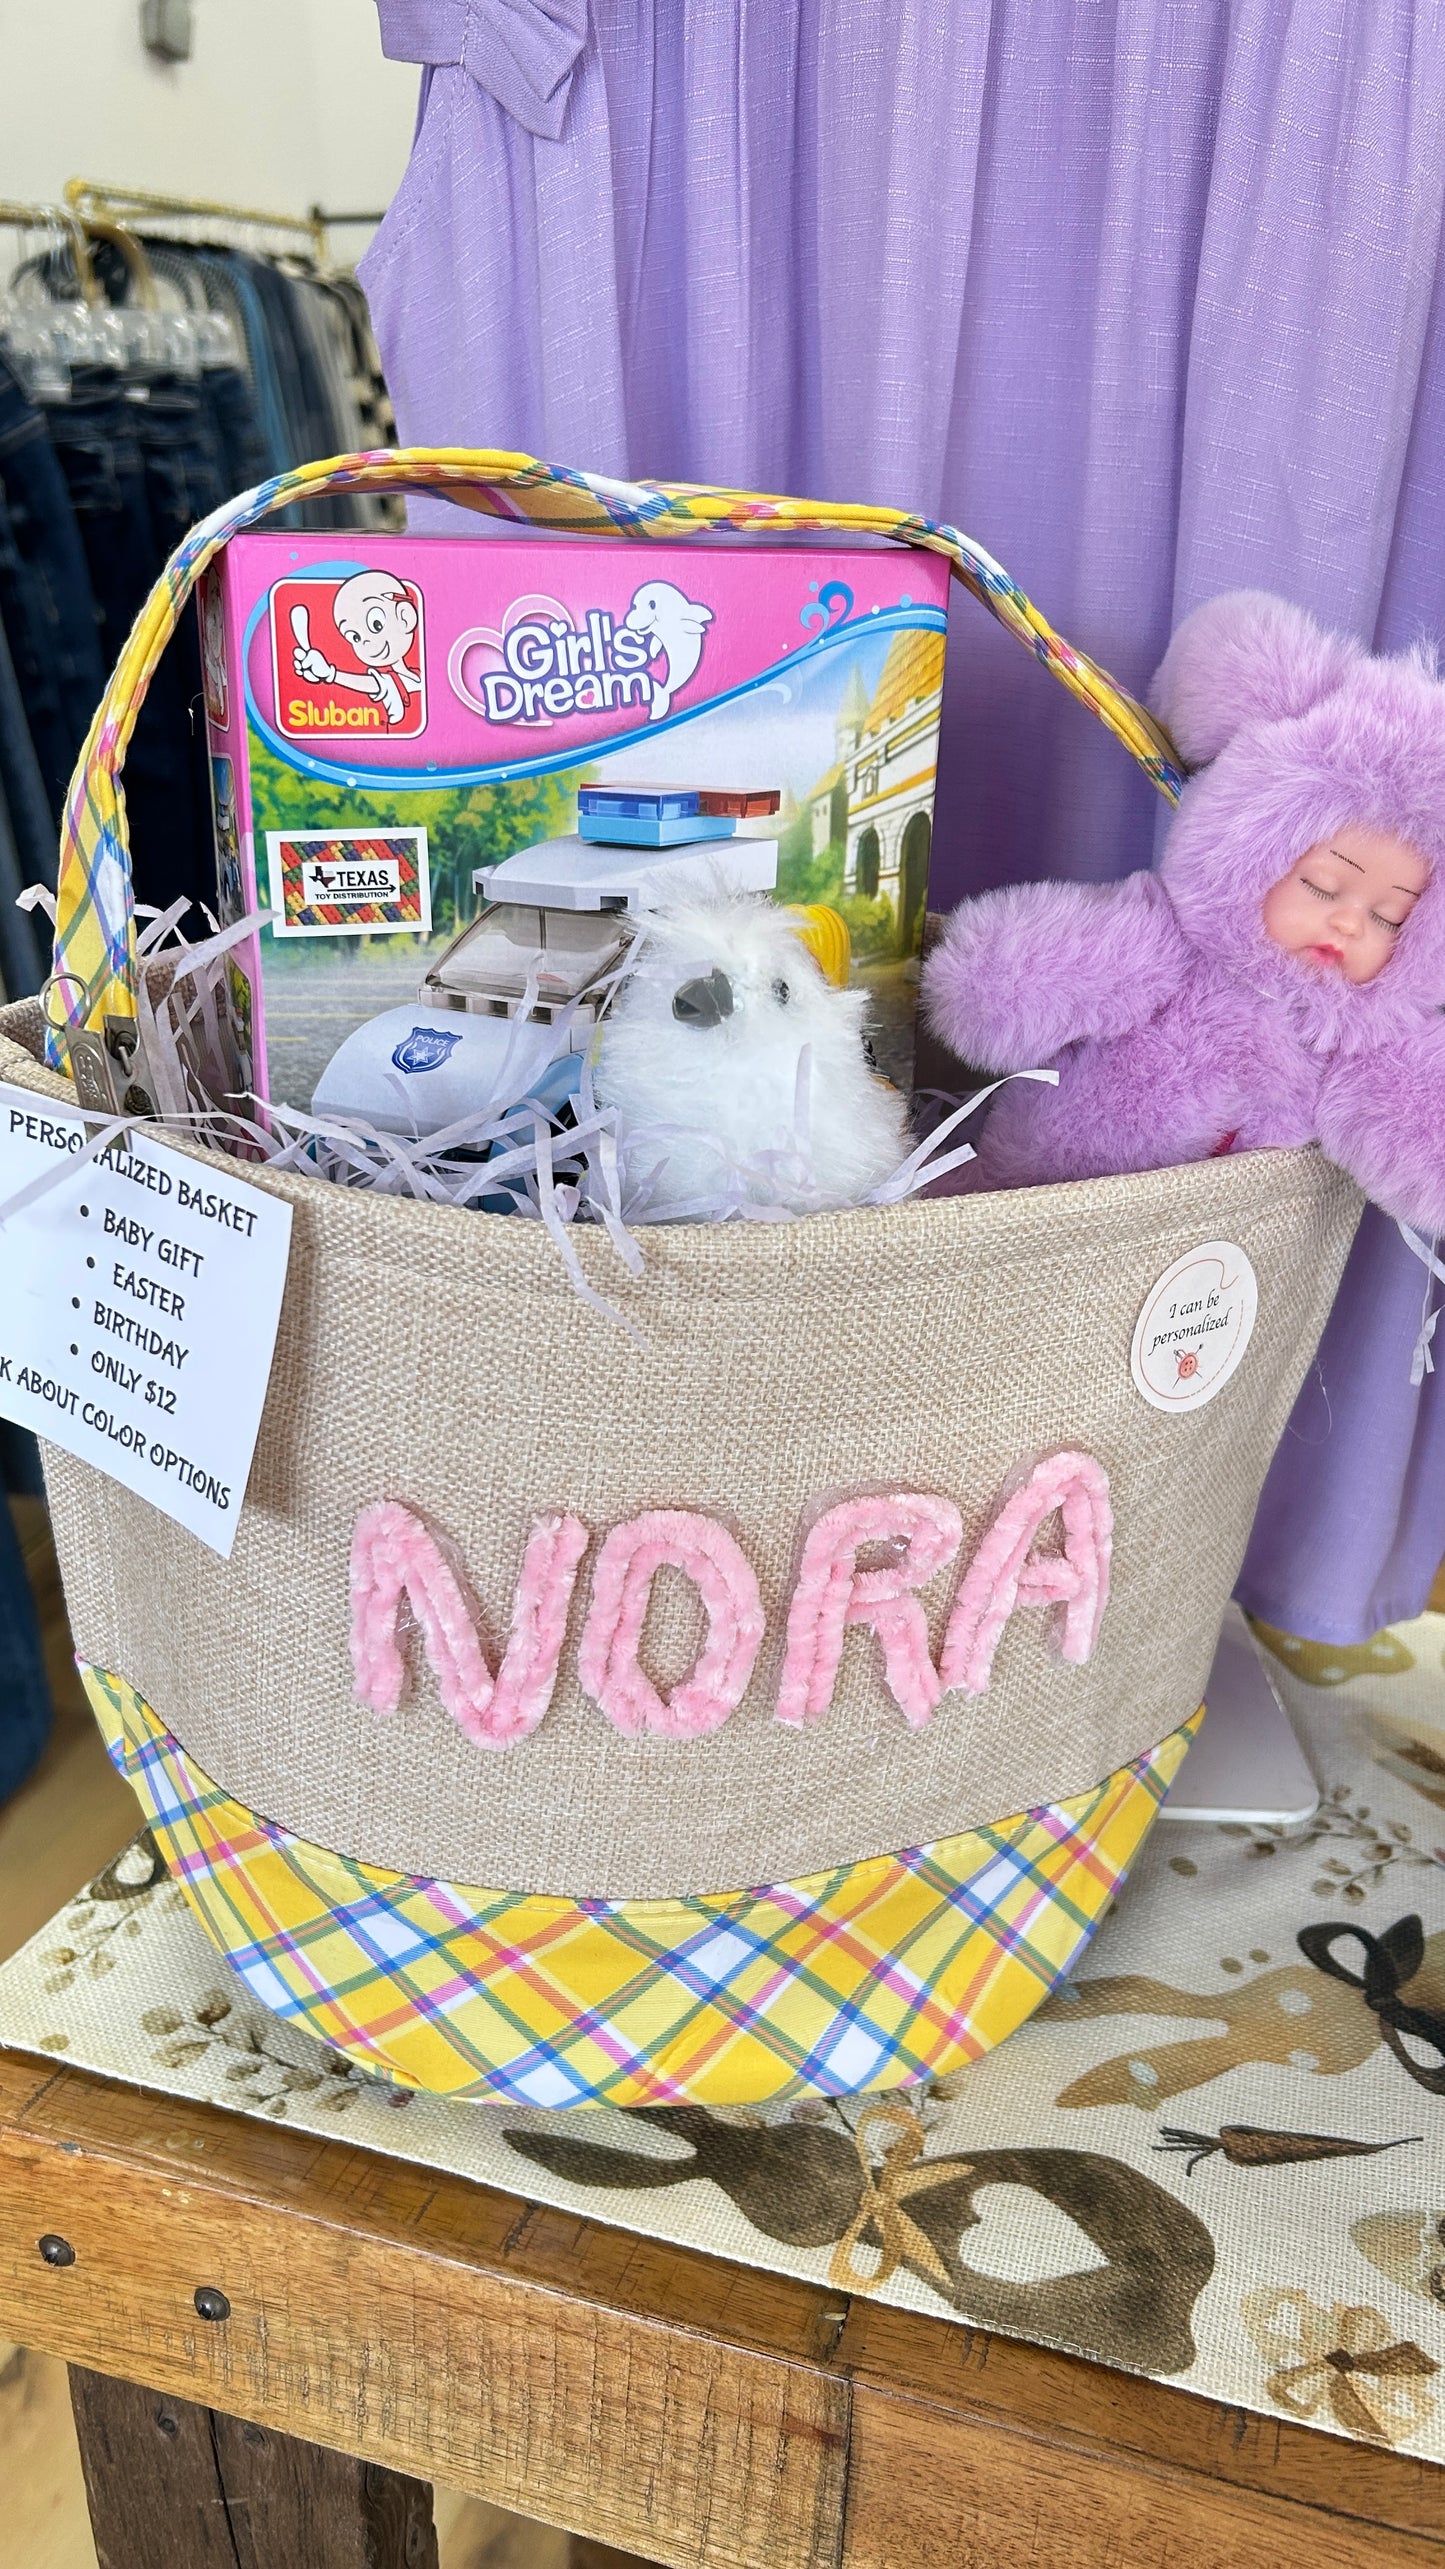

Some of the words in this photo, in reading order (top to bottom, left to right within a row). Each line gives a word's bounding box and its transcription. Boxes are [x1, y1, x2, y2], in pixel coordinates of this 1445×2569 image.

[505, 611, 650, 681] Girl's
[288, 699, 380, 727] Sluban
[483, 671, 652, 722] Dream
[336, 870, 389, 887] TEXAS
[415, 1034, 450, 1047] POLICE
[9, 1109, 173, 1196] PERSOALIZED
[178, 1179, 258, 1238] BASKET
[103, 1208, 154, 1254] BABY
[157, 1235, 204, 1279] GIFT
[113, 1262, 185, 1321] EASTER
[1169, 1302, 1178, 1319] I
[1180, 1298, 1203, 1317] can
[1206, 1288, 1220, 1309] be
[93, 1299, 189, 1370] BIRTHDAY
[1147, 1306, 1233, 1357] personalized
[91, 1350, 142, 1394] ONLY
[144, 1379, 178, 1415] $12
[16, 1366, 80, 1416] ABOUT
[82, 1402, 147, 1459] COLOR
[149, 1443, 232, 1510] OPTIONS
[348, 1449, 1114, 1752] NORA
